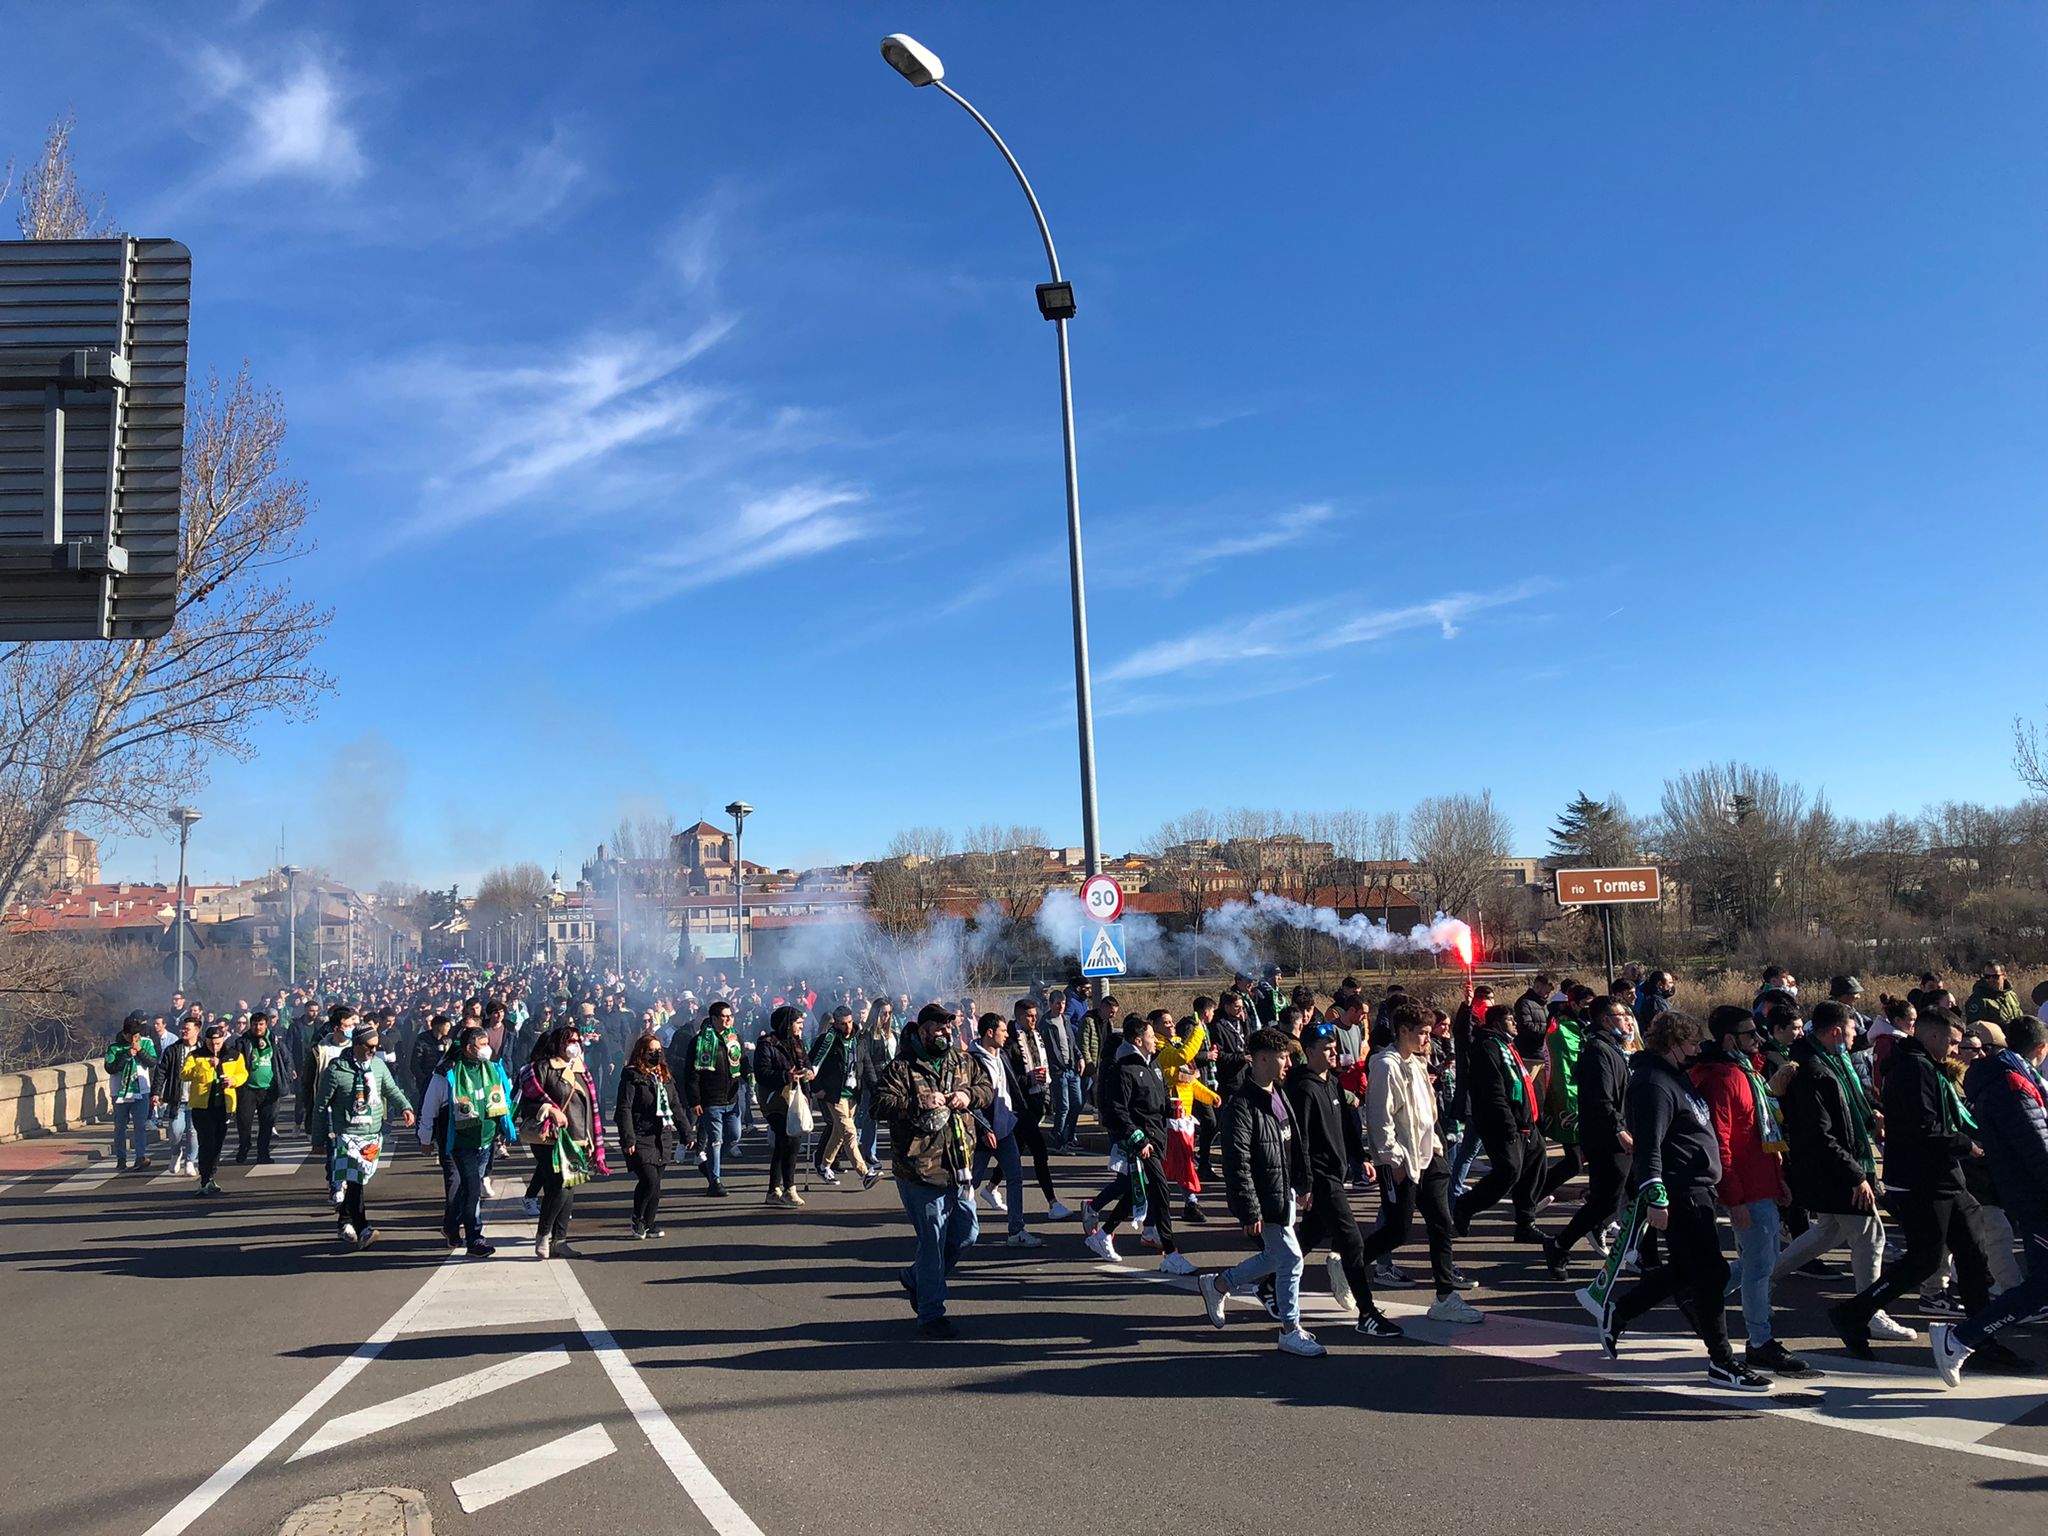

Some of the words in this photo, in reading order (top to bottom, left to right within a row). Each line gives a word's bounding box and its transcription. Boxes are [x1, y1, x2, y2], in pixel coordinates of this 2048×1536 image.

[1593, 879, 1646, 893] Tormes
[1091, 890, 1115, 906] 30
[1983, 1314, 2016, 1334] PARIS
